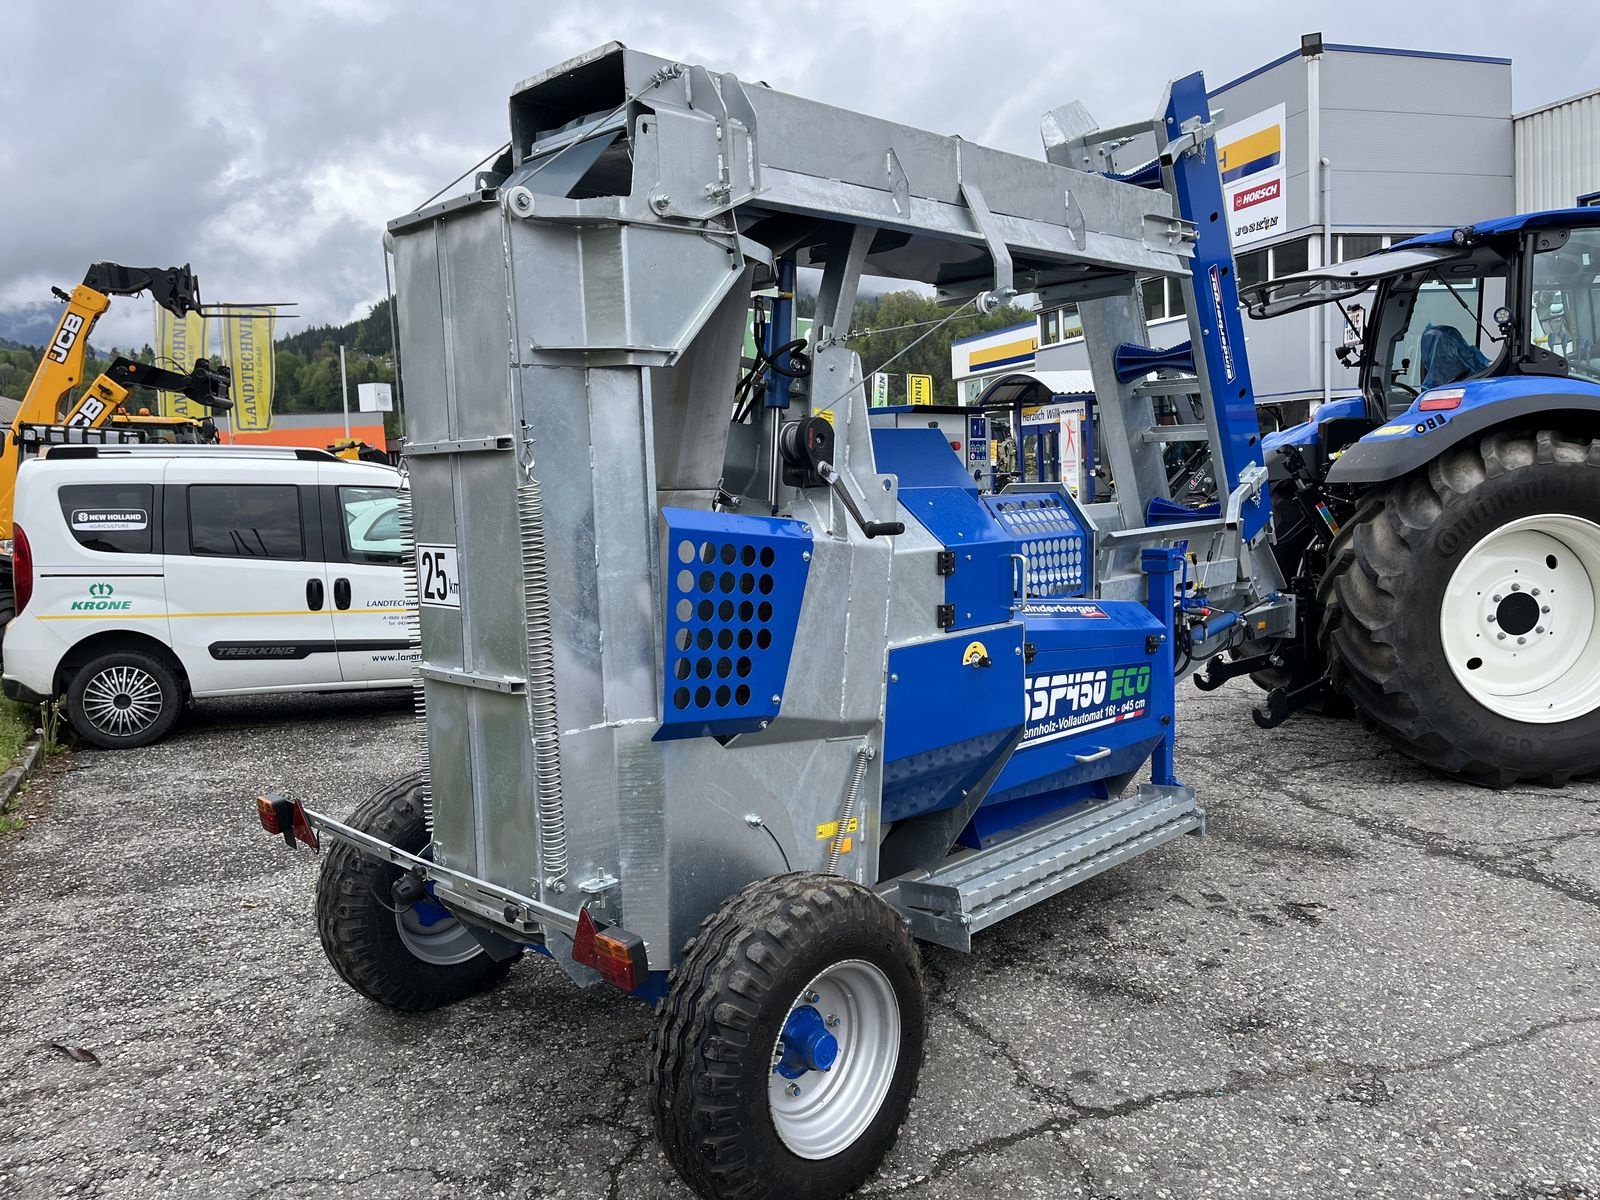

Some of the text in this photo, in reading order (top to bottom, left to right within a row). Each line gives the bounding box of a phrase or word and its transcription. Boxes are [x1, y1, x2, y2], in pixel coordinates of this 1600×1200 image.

[1242, 184, 1278, 205] HORSCH
[52, 313, 84, 363] JCB
[68, 397, 105, 427] CB
[1022, 409, 1045, 422] Herzlich
[107, 513, 142, 521] HOLLAND
[422, 551, 448, 601] 25
[71, 601, 133, 610] KRONE
[217, 646, 297, 656] TREKKING
[1110, 666, 1151, 700] ECO
[1024, 711, 1103, 739] ennholz-Vollautomat
[1104, 705, 1116, 718] 16t
[1134, 698, 1146, 710] cm
